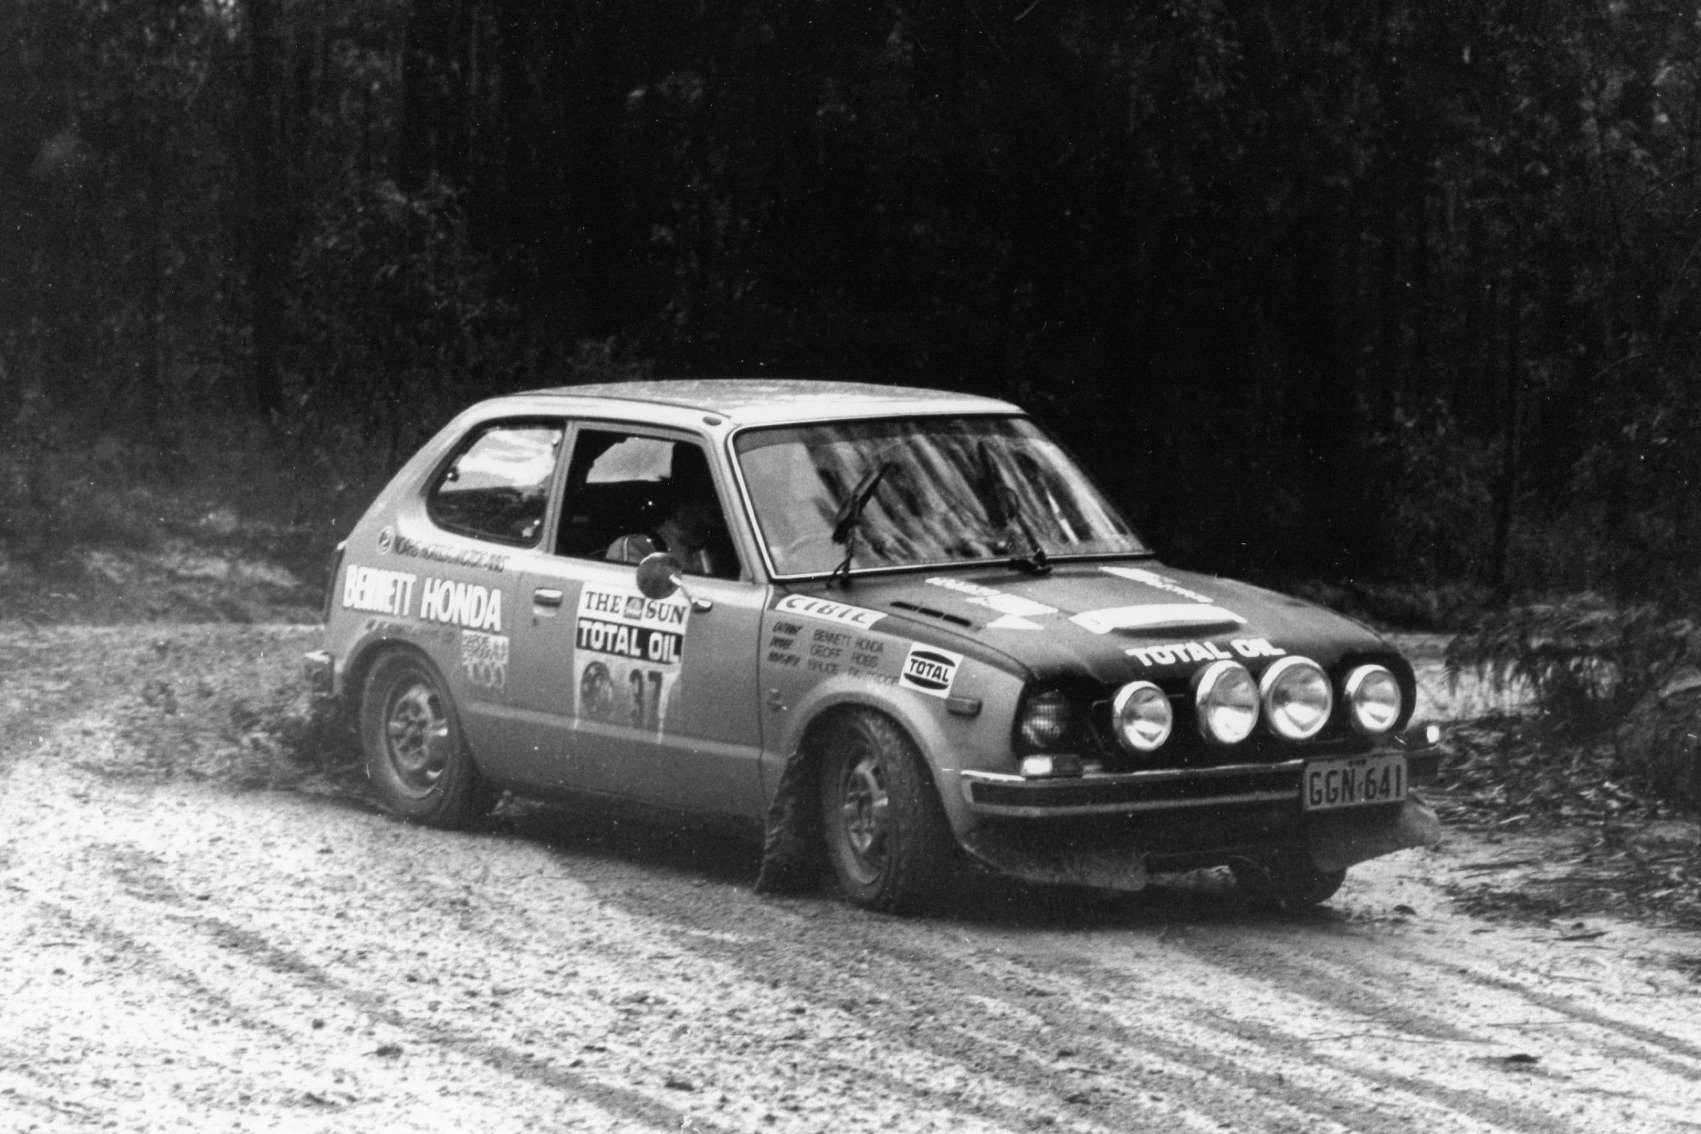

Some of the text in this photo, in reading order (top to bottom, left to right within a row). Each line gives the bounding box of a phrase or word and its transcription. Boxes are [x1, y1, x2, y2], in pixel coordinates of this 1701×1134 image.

[342, 563, 502, 632] BENNETT HONDA
[586, 591, 688, 625] THE SUN
[579, 619, 681, 664] TOTAL OIL
[810, 644, 843, 659] GEOFF
[855, 638, 884, 655] HONDA
[1124, 638, 1287, 667] TOTAL OIL
[909, 657, 949, 683] TOTAL
